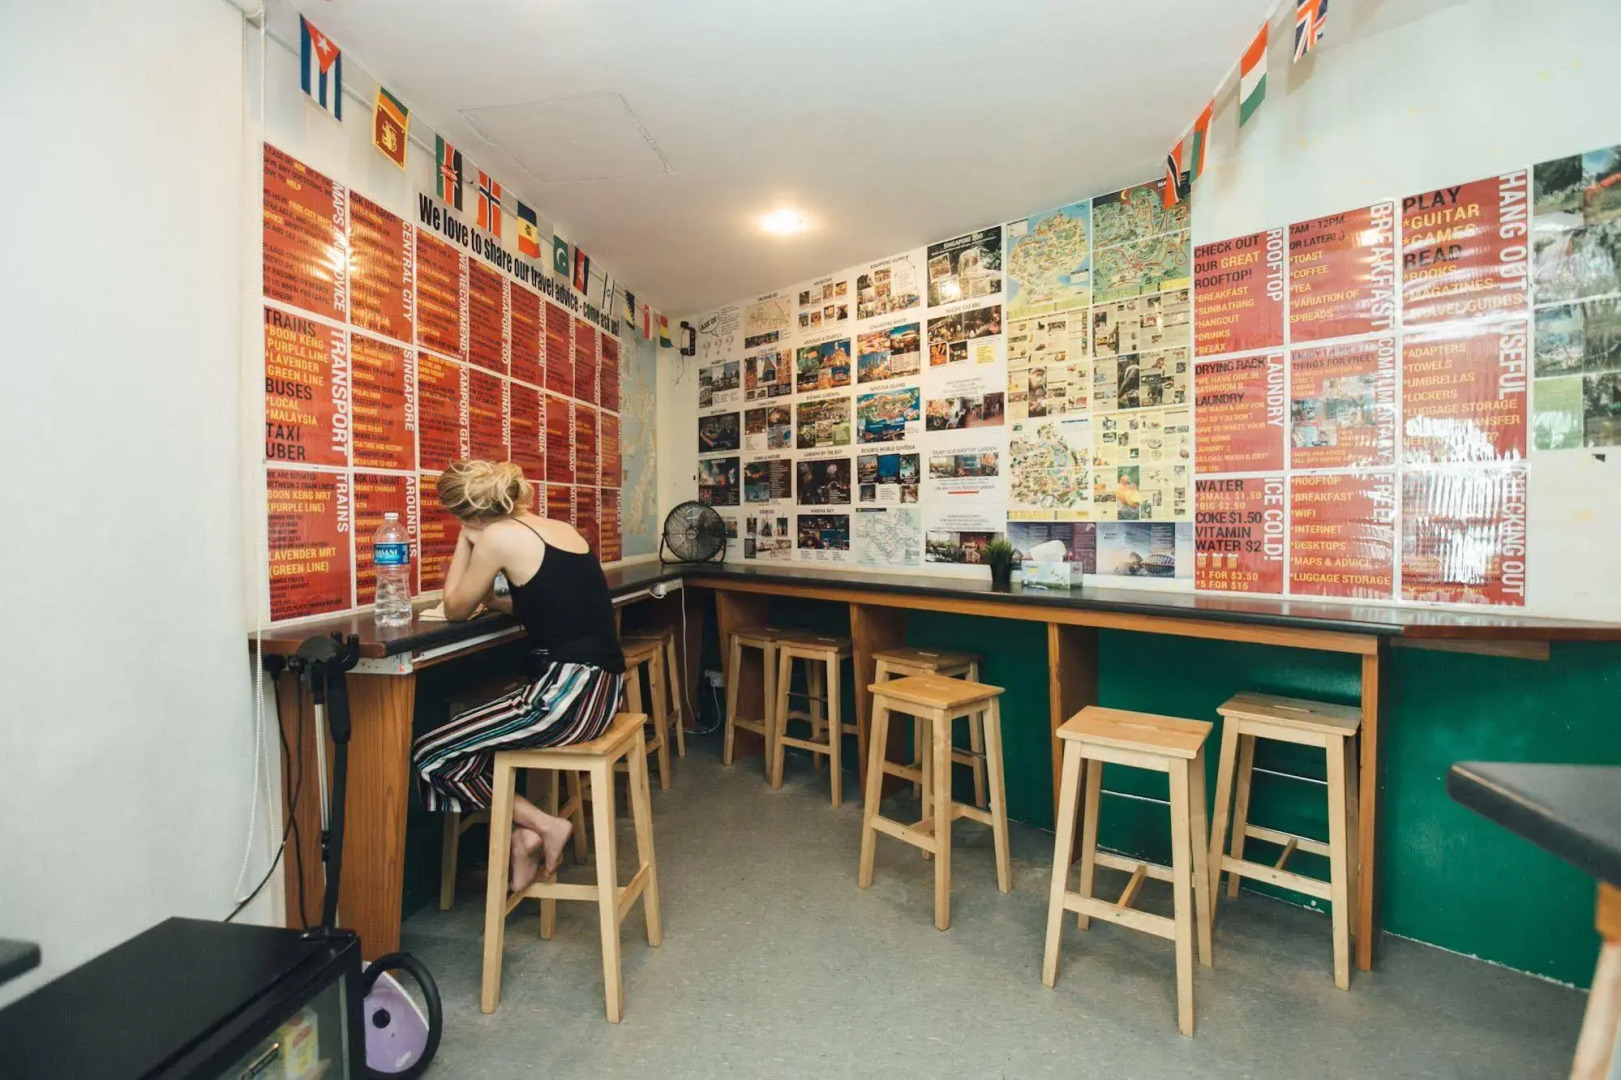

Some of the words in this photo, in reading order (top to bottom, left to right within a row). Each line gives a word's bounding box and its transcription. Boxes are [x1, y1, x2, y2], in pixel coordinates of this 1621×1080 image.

[332, 181, 345, 227] MAPS
[1403, 185, 1462, 213] PLAY
[1499, 170, 1526, 240] HANG
[1411, 204, 1480, 230] GUITAR
[1290, 224, 1309, 235] 7AM
[1411, 223, 1476, 246] GAMES
[1194, 242, 1232, 259] CHECK
[1236, 235, 1259, 249] OUT
[1290, 241, 1301, 250] OR
[1304, 232, 1336, 246] LATER!
[402, 222, 413, 284] CENTRAL
[419, 192, 440, 230] We
[443, 210, 468, 248] love
[472, 228, 482, 255] to
[484, 235, 512, 272] share
[514, 258, 529, 282] our
[531, 264, 554, 296] travel
[556, 283, 578, 312] advice
[1293, 250, 1324, 264] TOAST
[1403, 244, 1462, 270] READ
[459, 254, 466, 273] WE
[1194, 260, 1218, 274] OUR
[1221, 251, 1260, 269] GREAT
[1266, 228, 1283, 302] ROOFTOP
[1370, 202, 1395, 330] BREAKFAST
[1500, 246, 1527, 290] OUT
[1194, 269, 1253, 290] ROOFTOP!
[1293, 265, 1329, 279] COFFEE
[1410, 264, 1457, 281] BOOKS
[333, 258, 346, 312] DVICE
[1293, 283, 1312, 294] TEA
[1198, 286, 1249, 302] BREAKFAST
[1293, 291, 1344, 308] VARIATION
[1346, 289, 1360, 299] OF
[403, 288, 413, 322] CITY
[1198, 299, 1255, 315] SUNBATHING
[264, 306, 316, 337] TRAINS
[1198, 314, 1240, 328] HANGOUT
[1290, 308, 1333, 324] SPREADS
[269, 326, 296, 343] BOON
[300, 334, 324, 350] KENG
[1198, 329, 1231, 341] DRINKS
[268, 337, 306, 357] PURPLE
[308, 350, 329, 364] LINE
[1199, 343, 1226, 354] RELAX
[1408, 343, 1466, 358] ADAPTERS
[270, 352, 319, 373] LAVENDER
[1196, 361, 1234, 375] DRYING
[1236, 357, 1266, 370] RACK
[1293, 360, 1324, 370] THINGS
[1327, 357, 1345, 367] FOR
[1348, 355, 1374, 364] FREE!
[1408, 360, 1453, 372] TOWELS
[1499, 322, 1526, 400] USEFUL
[268, 364, 300, 382] GREEN
[304, 372, 324, 386] LINE
[1408, 372, 1476, 388] UMBRELLAS
[266, 377, 312, 400] BUSES
[331, 330, 348, 456] TRANSPORT
[404, 350, 414, 432] SINGAPORE
[460, 366, 468, 425] KAMPONG
[1267, 352, 1283, 426] LAUNDRY
[1408, 389, 1458, 402] LOCKERS
[270, 397, 300, 411] LOCAL
[1196, 392, 1244, 406] LAUNDRY
[1408, 404, 1460, 416] LUGGAGE
[1462, 399, 1517, 412] STORAGE
[270, 409, 318, 426] MALAYSIA
[266, 423, 300, 441] TAXI
[266, 442, 306, 461] UBER
[354, 474, 367, 484] ASK
[370, 474, 378, 484] US
[1196, 480, 1244, 492] WATER
[1295, 476, 1341, 486] ROOFTOP
[267, 490, 290, 499] BOON
[293, 490, 314, 500] KENG
[315, 491, 331, 500] MRT
[1200, 492, 1231, 500] SMALL
[1235, 491, 1262, 500] $1.50
[1264, 478, 1283, 505] ICE
[1295, 492, 1352, 501] BREAKFAST
[1374, 473, 1392, 523] FREE!
[268, 502, 303, 513] (PURPLE
[305, 503, 325, 514] LINE)
[336, 473, 348, 532] TRAINS
[406, 477, 416, 534] AROUND
[1219, 501, 1246, 510] $2.50
[1196, 512, 1226, 523] COKE
[1230, 511, 1262, 524] $1.50
[1295, 509, 1316, 518] WIFI
[1196, 526, 1251, 538] VITAMIN
[1264, 509, 1283, 560] COLD!
[1295, 525, 1343, 534] INTERNET
[269, 549, 316, 561] LAVENDER
[319, 547, 336, 557] MRT
[1196, 539, 1241, 551] WATER
[1246, 540, 1262, 552] $2
[1295, 541, 1346, 551] DESKTOPS
[269, 564, 304, 578] (GREEN
[307, 561, 329, 573] LINE)
[1294, 557, 1322, 566] MAPS
[1325, 558, 1332, 566] &
[1209, 571, 1227, 579] FOR
[1231, 571, 1258, 581] $3.50
[1294, 573, 1339, 583] LUGGAGE
[1342, 575, 1391, 585] STORAGE
[1502, 561, 1524, 596] OUT
[1209, 581, 1228, 589] FOR
[1231, 581, 1248, 590] $15
